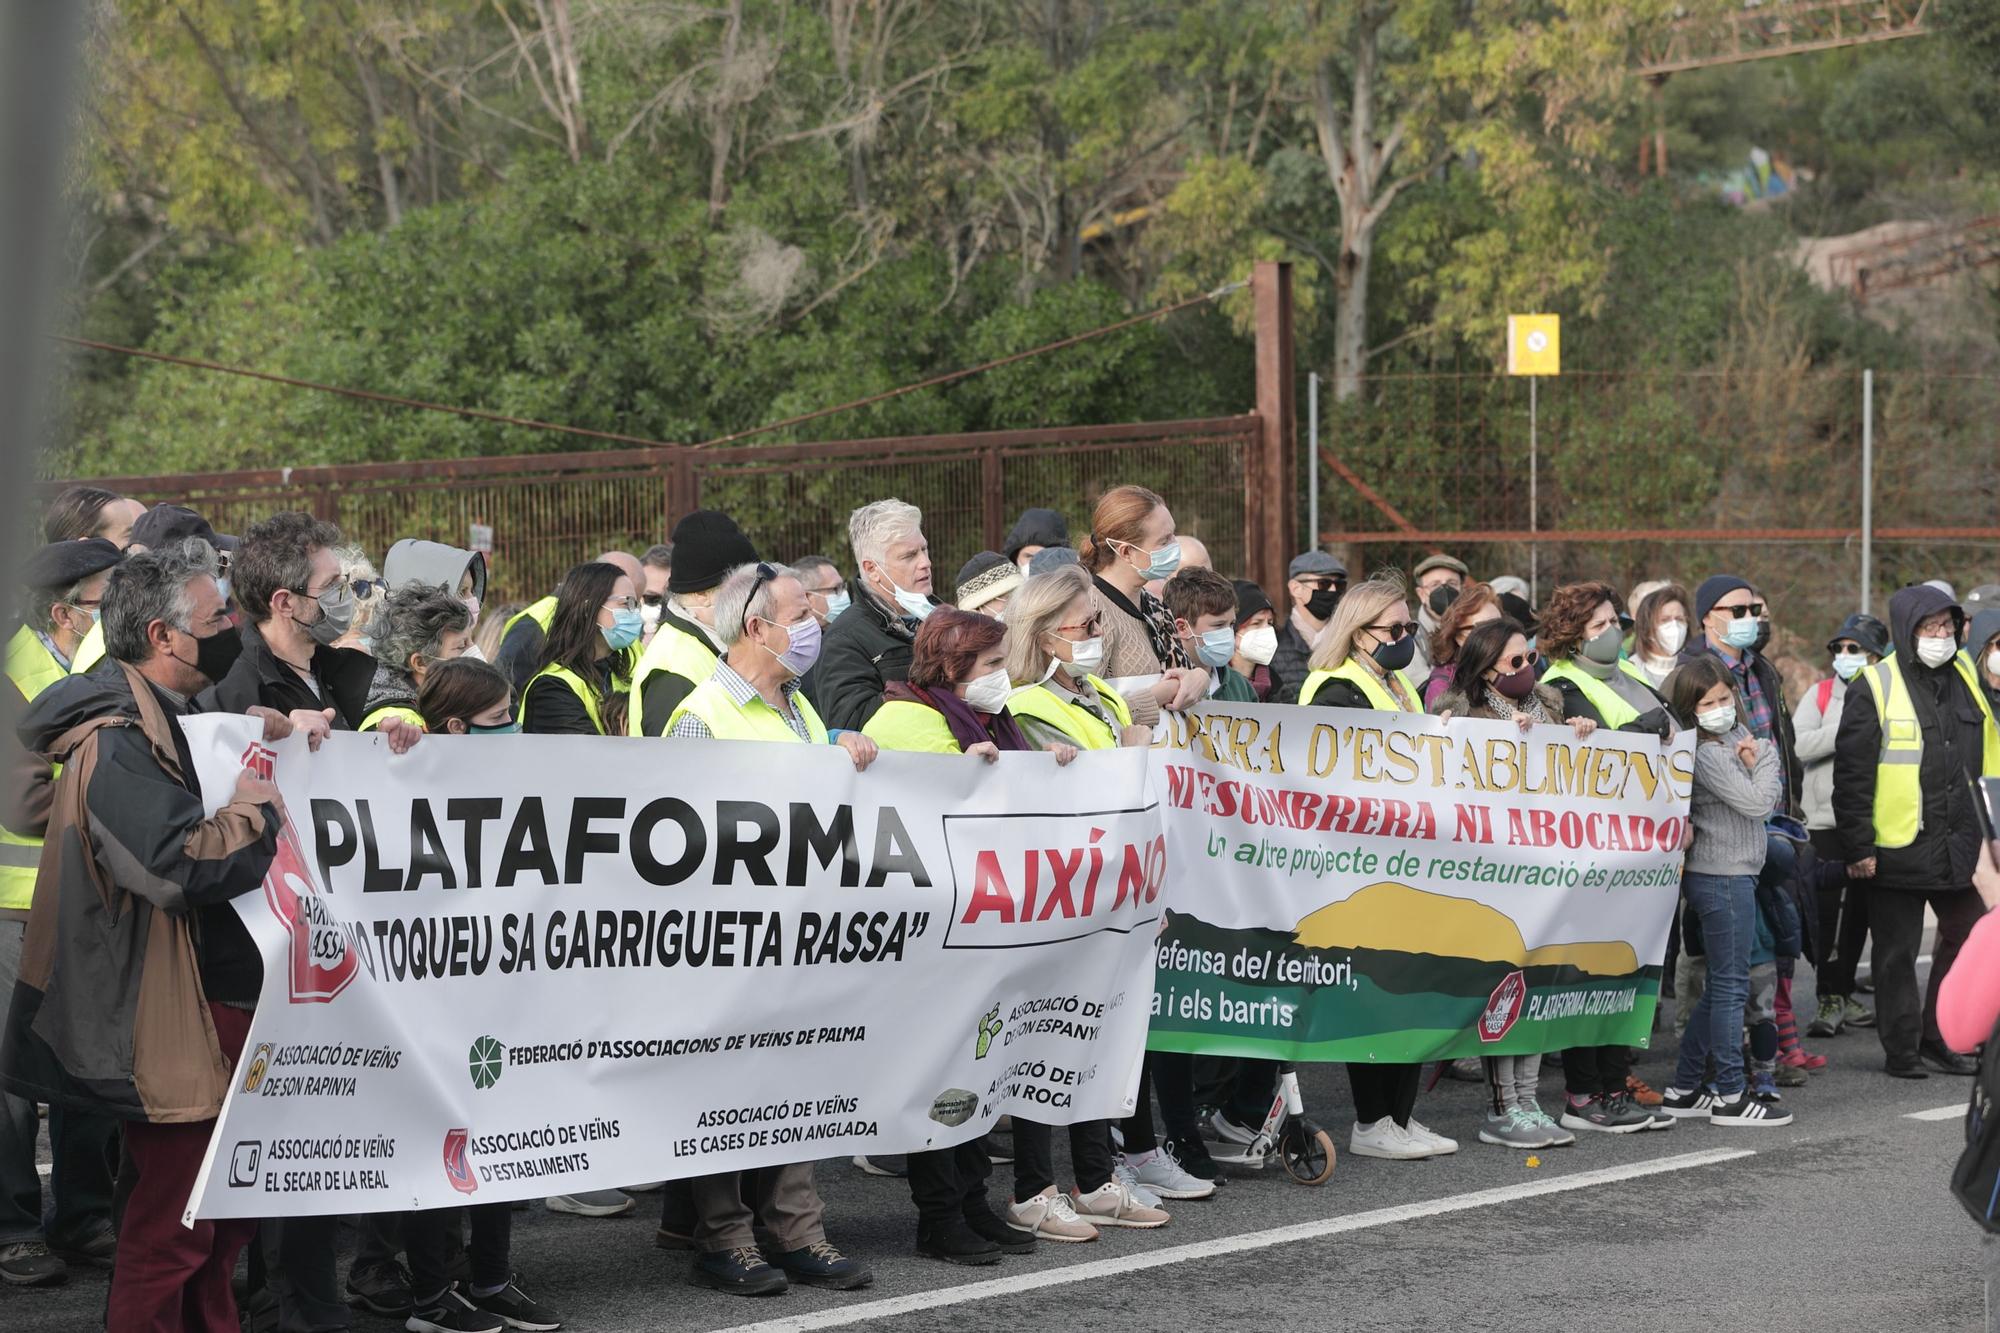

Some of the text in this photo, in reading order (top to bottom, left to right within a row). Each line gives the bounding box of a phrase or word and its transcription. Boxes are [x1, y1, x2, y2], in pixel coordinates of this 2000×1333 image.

[1165, 764, 1195, 810] NI
[1197, 771, 1437, 840] ESCOMBRERA
[1452, 803, 1495, 844] NI
[310, 796, 933, 894] PLATAFORMA
[960, 827, 1166, 924] AIXÍ NO
[1234, 838, 1287, 869] altre
[1290, 844, 1379, 879] projecte
[1386, 849, 1421, 877] de
[1428, 856, 1579, 889] restauració
[1583, 862, 1608, 887] és
[374, 915, 492, 984] TOQUEU
[499, 912, 536, 974] SA
[545, 909, 782, 970] GARRIGUETA
[1232, 947, 1272, 980] del
[1082, 1002, 1104, 1018] DE
[1168, 986, 1175, 1017] i
[1179, 989, 1212, 1021] els
[1219, 991, 1294, 1027] barris
[509, 1025, 866, 1066] FEDERACIÓ D'ASSOCIACIONS DE VEÏNS DE PALMA
[1017, 1020, 1036, 1038] ON
[273, 1042, 402, 1070] ASSOCIACIÓ DE VEÏNS
[262, 1077, 357, 1097] DE SON RAPINYA
[1049, 1067, 1076, 1086] DE
[696, 1095, 859, 1128] ASSOCIACIÓ DE VEÏNS
[1022, 1084, 1072, 1108] ROCA
[268, 1133, 395, 1160] ASSOCIACIÓ DE VEÏNS
[471, 1117, 621, 1156] ASSOCIACIÓ DE VEÏNS
[674, 1121, 878, 1157] LES CASES DE SON ANGLADA
[265, 1170, 390, 1192] EL SECAR DE LA REAL
[479, 1153, 590, 1183] D'ESTABLIMENTS
